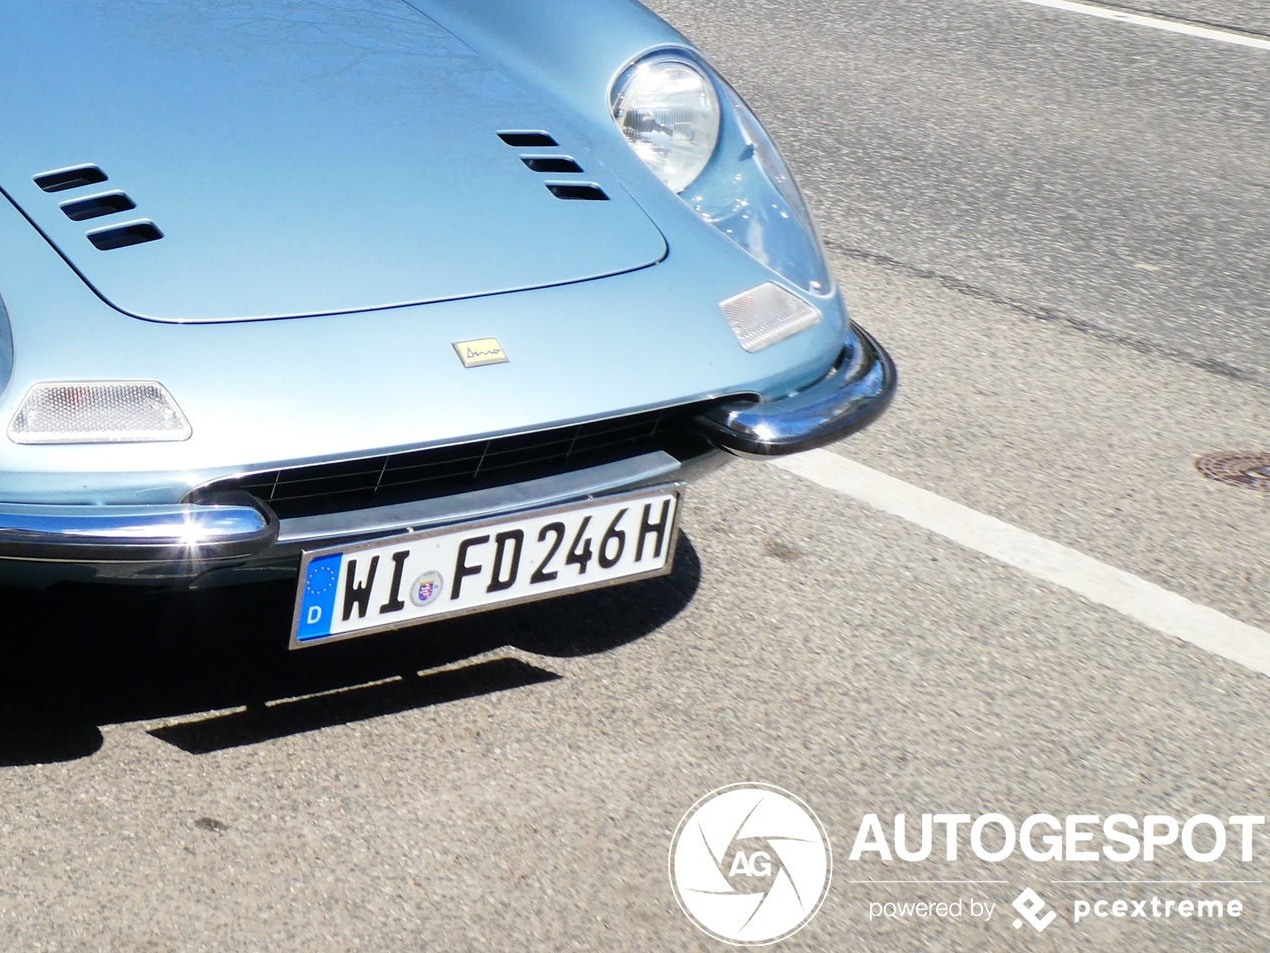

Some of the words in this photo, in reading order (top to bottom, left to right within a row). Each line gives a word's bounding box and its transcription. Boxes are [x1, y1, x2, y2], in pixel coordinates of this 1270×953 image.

[466, 347, 501, 359] Dino
[306, 605, 322, 625] D
[341, 549, 411, 622] WI
